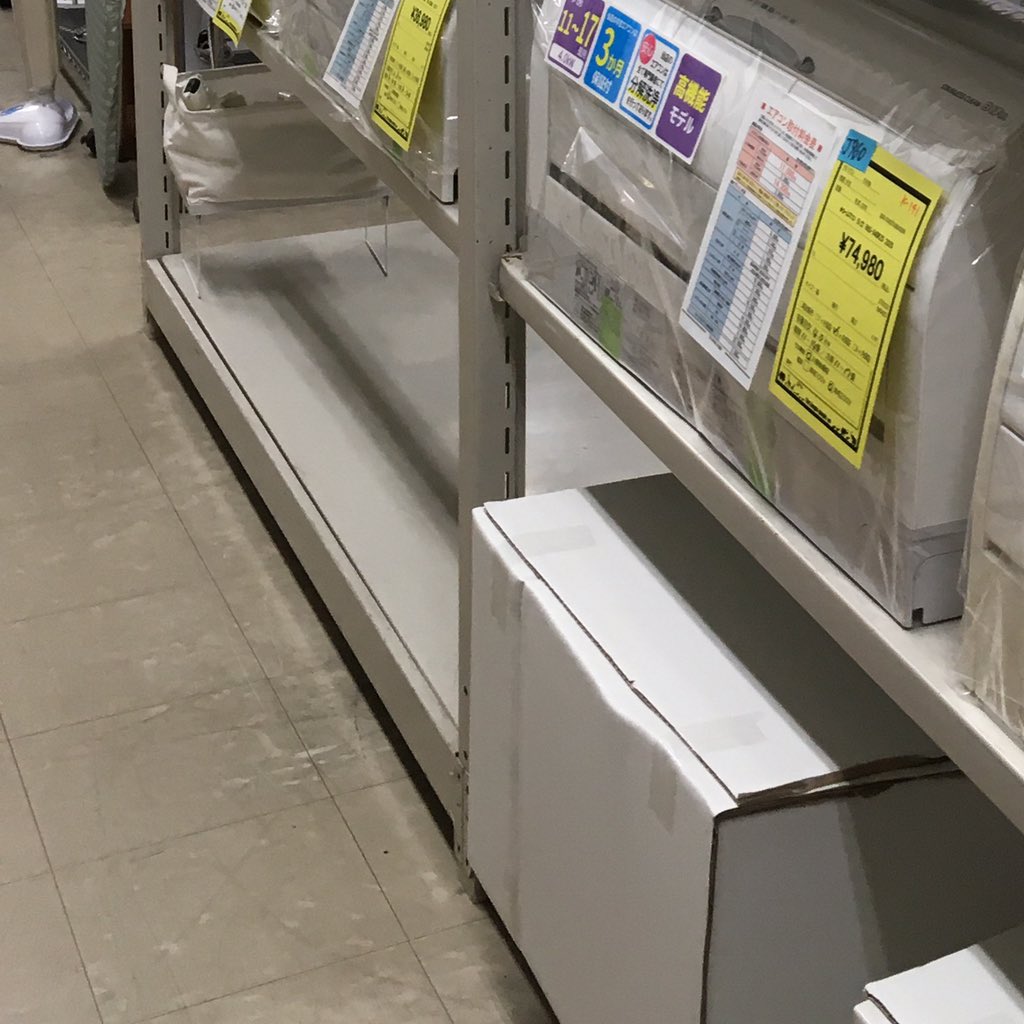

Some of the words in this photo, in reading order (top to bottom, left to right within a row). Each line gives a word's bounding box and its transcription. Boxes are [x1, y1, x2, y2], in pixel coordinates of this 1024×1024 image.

[672, 74, 711, 114] 高機能
[669, 106, 695, 135] モデル
[839, 232, 884, 281] ¥74,980
